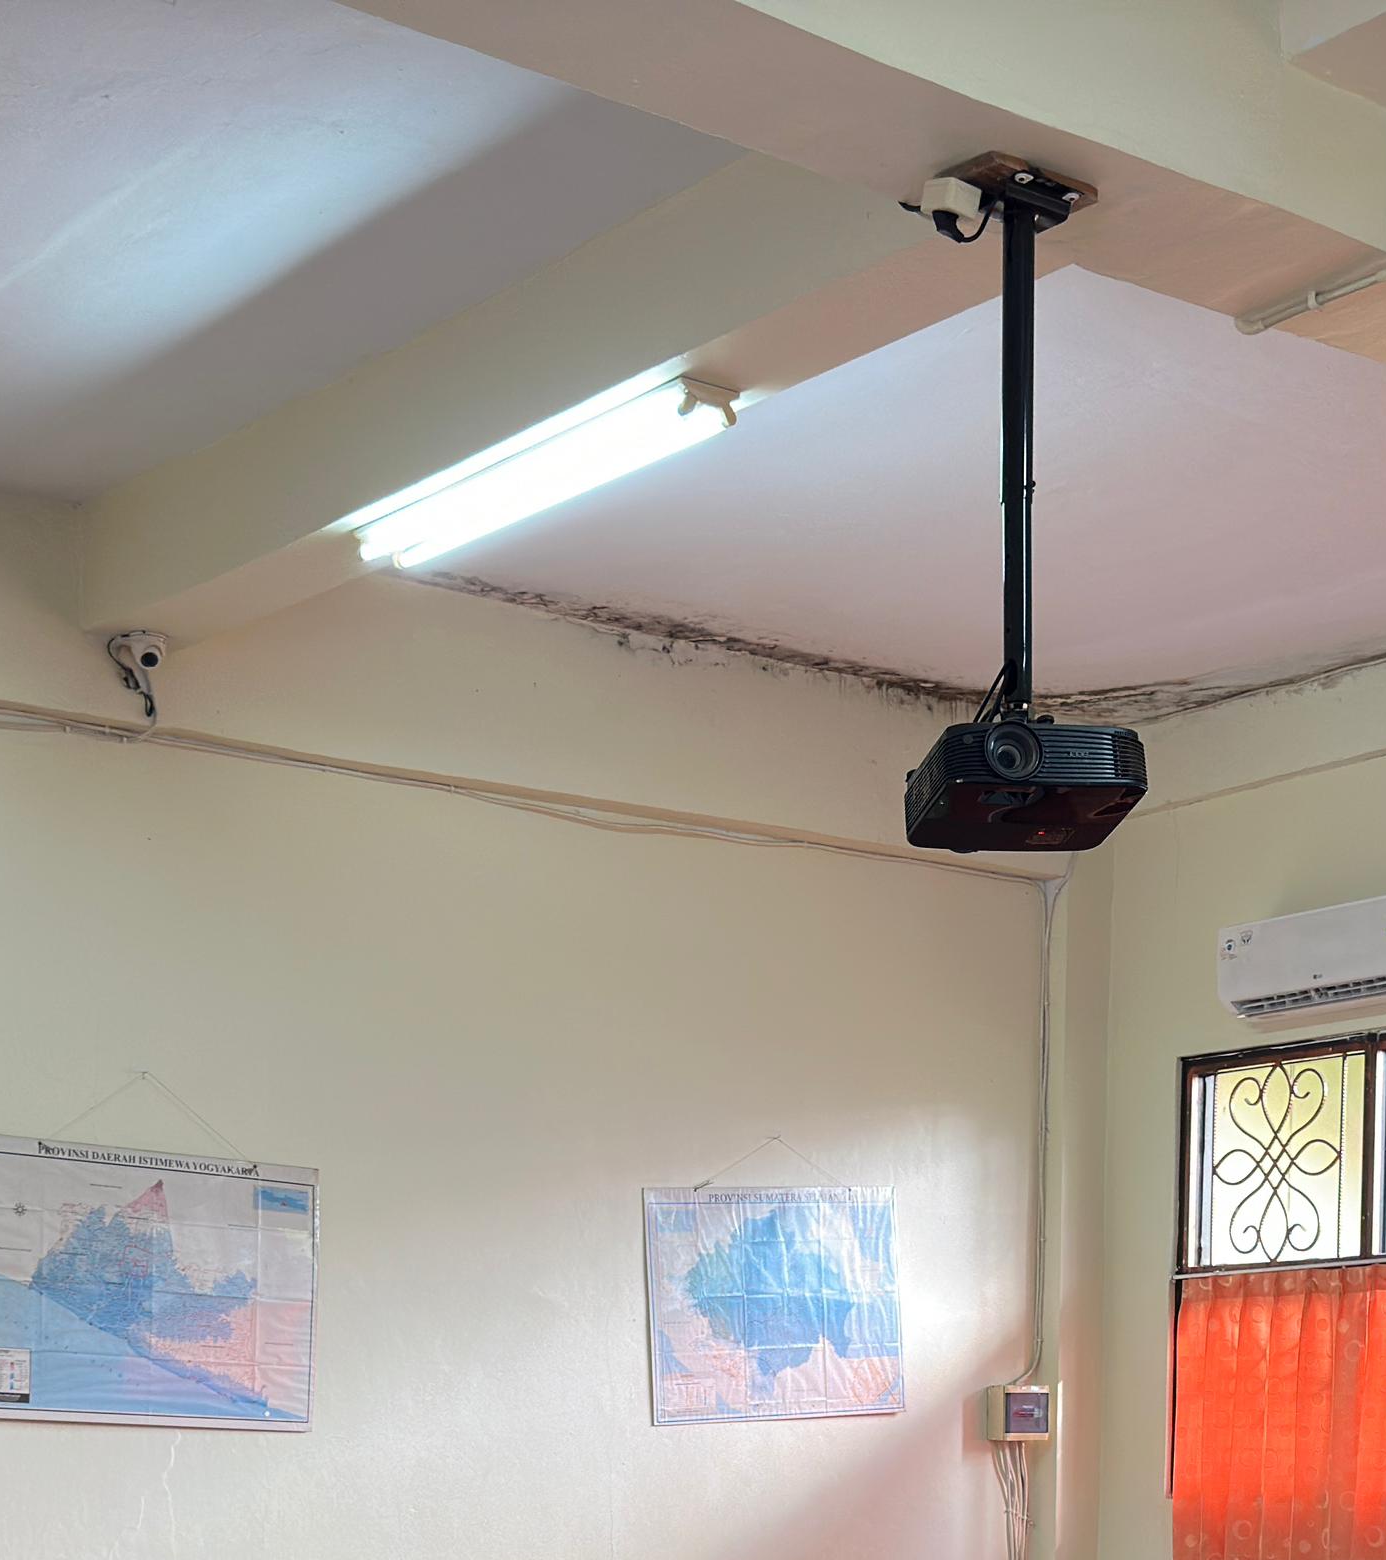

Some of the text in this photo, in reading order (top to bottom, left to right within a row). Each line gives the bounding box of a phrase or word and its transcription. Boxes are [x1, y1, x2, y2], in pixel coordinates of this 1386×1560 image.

[37, 1144, 89, 1159] PROVINSI
[92, 1151, 135, 1164] DAERAH
[138, 1155, 190, 1170] ISTIMEWA
